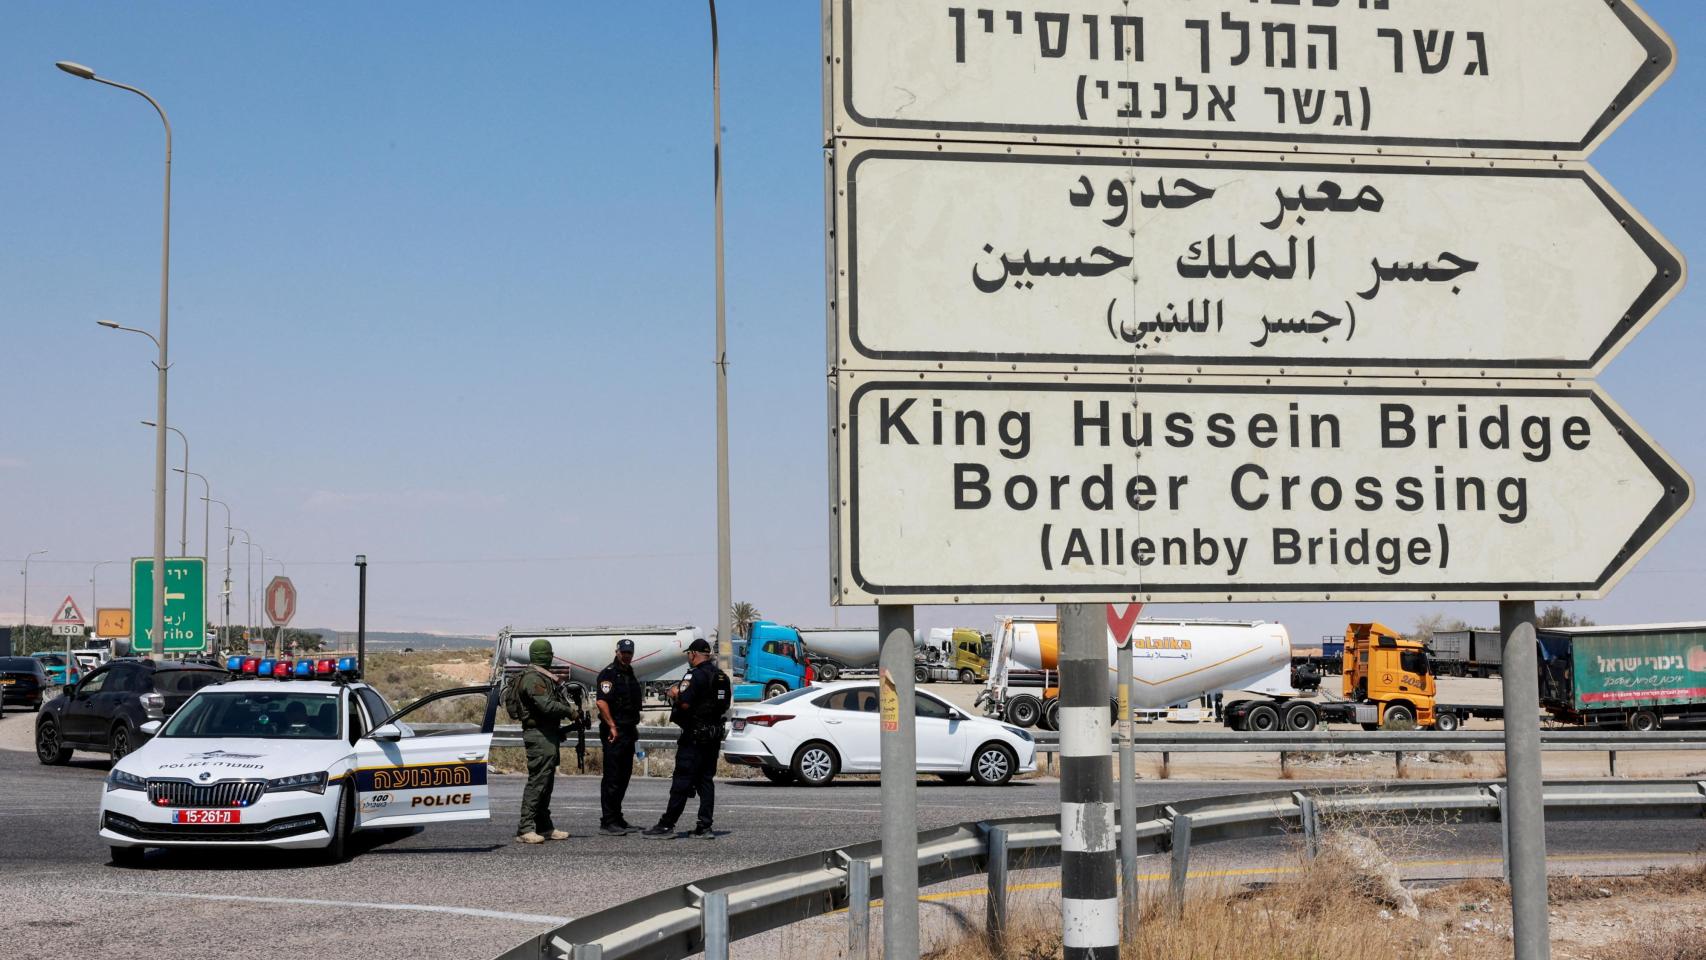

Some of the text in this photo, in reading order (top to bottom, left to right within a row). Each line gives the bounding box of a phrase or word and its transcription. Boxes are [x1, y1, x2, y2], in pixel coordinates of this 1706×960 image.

[948, 8, 1488, 76] גשר המלך חוסיין
[1076, 75, 1371, 130] (גשר אלנבי)
[1069, 175, 1385, 230] معبر حدود
[972, 234, 1479, 300] جسر الملك حسين
[1107, 298, 1356, 350] (جسر اللنبي)
[879, 397, 1591, 463] King Hussein Bridge
[953, 463, 1528, 524] Border Crossing
[1040, 524, 1450, 576] (Allenby Bridge)
[58, 626, 78, 634] 150
[145, 628, 194, 640] Yriho
[1597, 655, 1685, 673] ביכורי ישראל
[158, 761, 209, 770] POLICE
[213, 761, 265, 770] משטרה
[374, 766, 471, 789] התנועה
[372, 794, 389, 802] 100
[411, 793, 472, 808] POLICE
